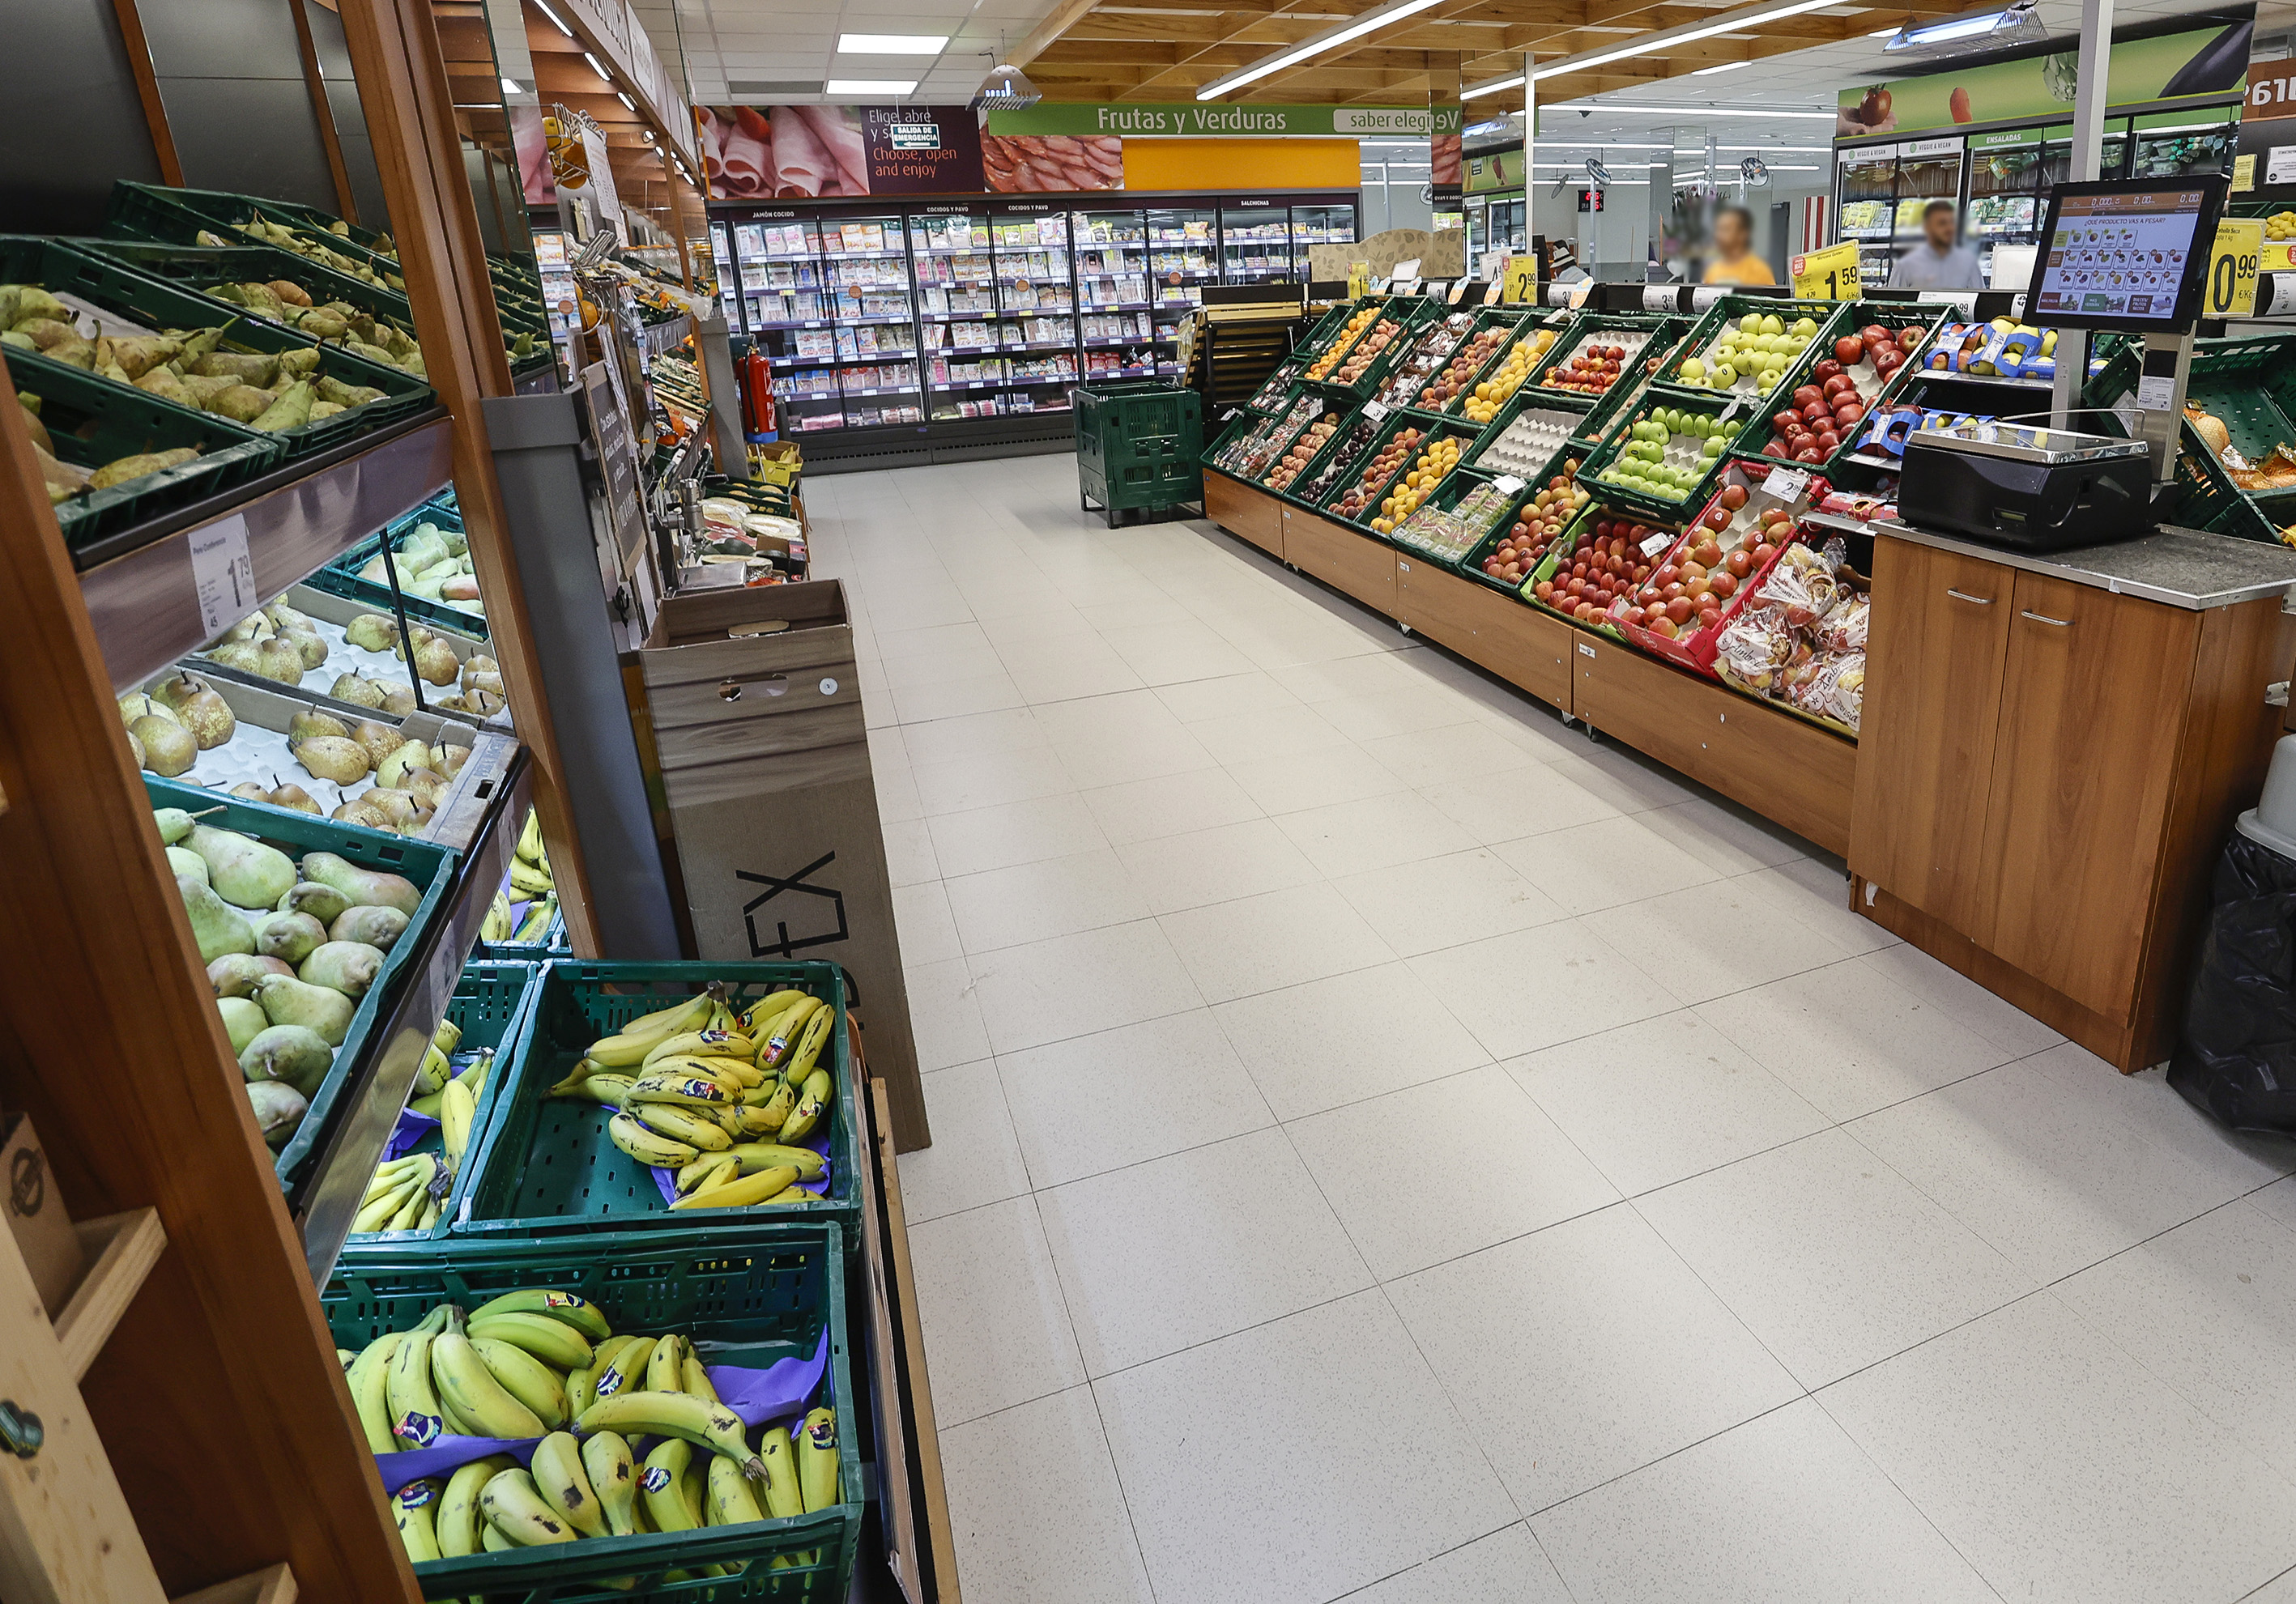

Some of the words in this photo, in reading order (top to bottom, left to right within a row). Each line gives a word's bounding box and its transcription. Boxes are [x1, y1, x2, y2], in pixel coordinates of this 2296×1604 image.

[869, 109, 901, 126] Elige,
[905, 108, 931, 123] abre
[1098, 107, 1166, 130] Frutas
[1173, 113, 1186, 134] y
[1193, 106, 1287, 130] Verduras
[1350, 111, 1391, 127] saber
[871, 128, 878, 143] y
[1986, 134, 2021, 144] ENSALADAS
[873, 147, 922, 161] Choose,
[926, 149, 957, 163] open
[875, 162, 898, 177] and
[902, 163, 935, 179] enjoy
